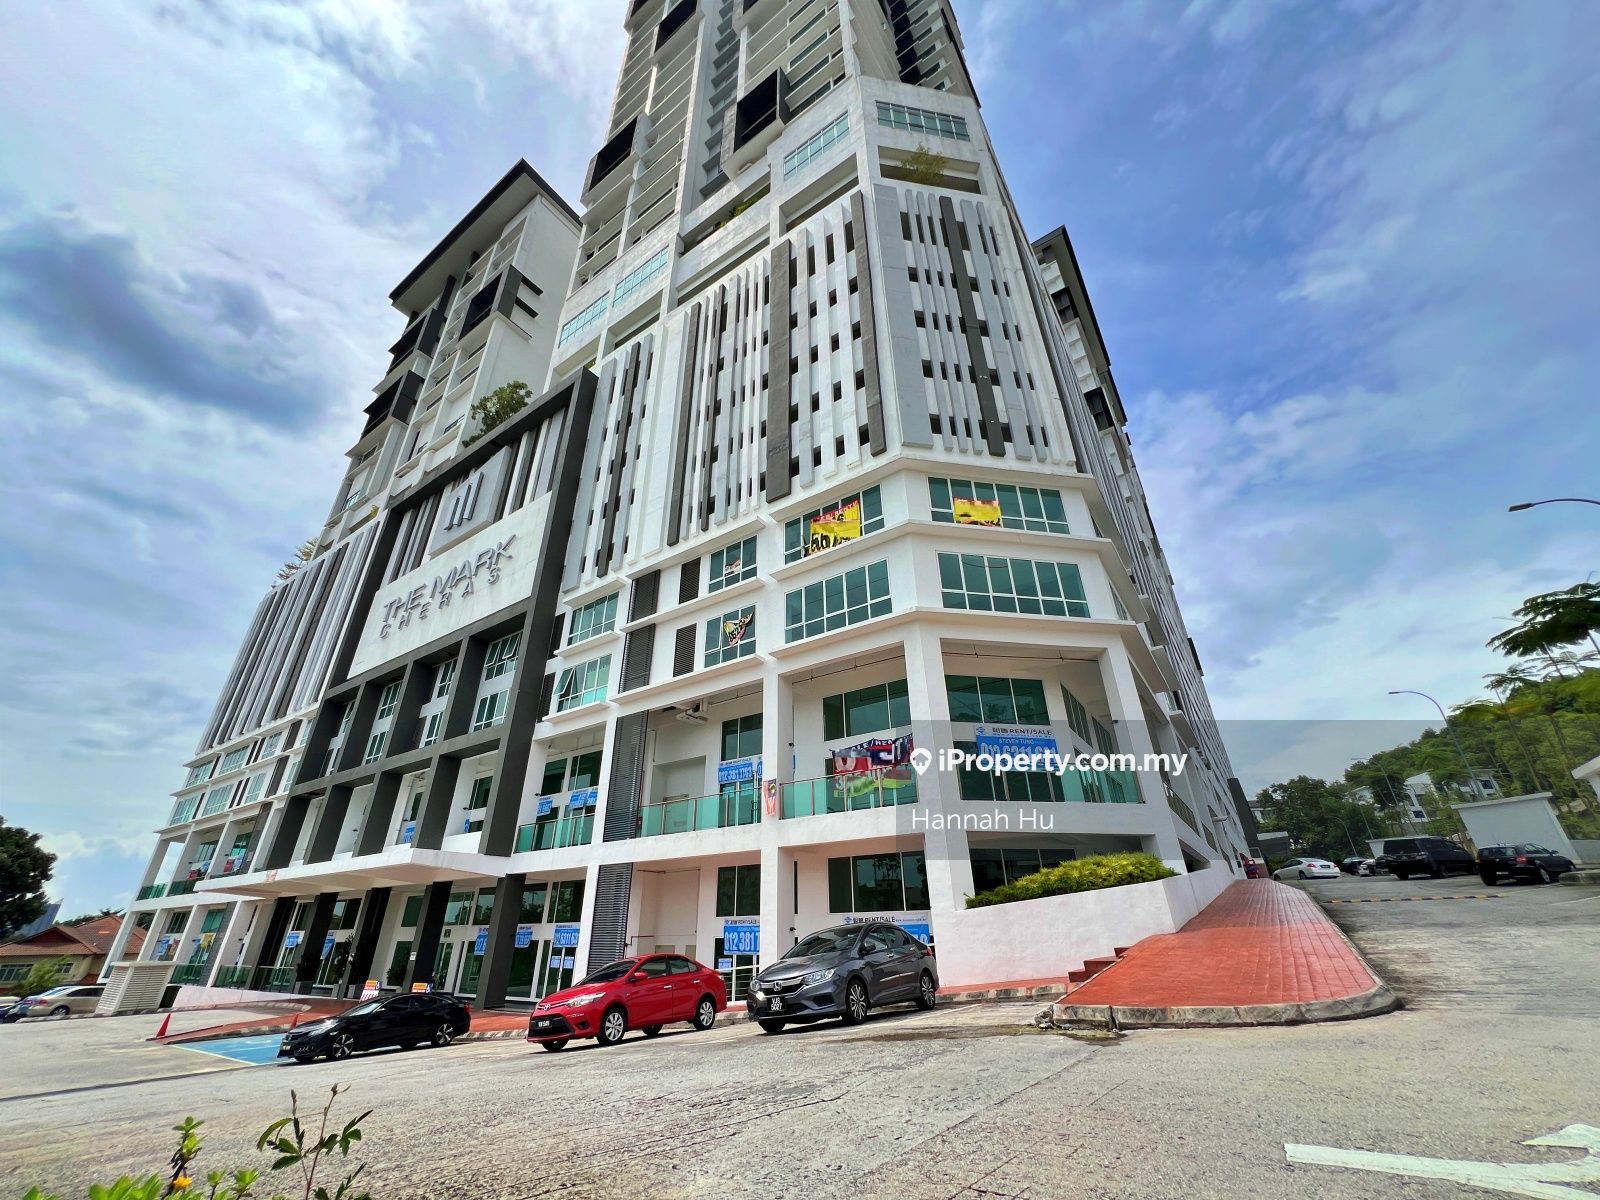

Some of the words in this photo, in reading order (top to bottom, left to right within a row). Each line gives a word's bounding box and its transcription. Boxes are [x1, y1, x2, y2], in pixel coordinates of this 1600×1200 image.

[379, 567, 502, 640] CHERAS
[383, 583, 427, 623] THE
[429, 534, 516, 599] MARK
[1009, 728, 1052, 736] RENT/SALE
